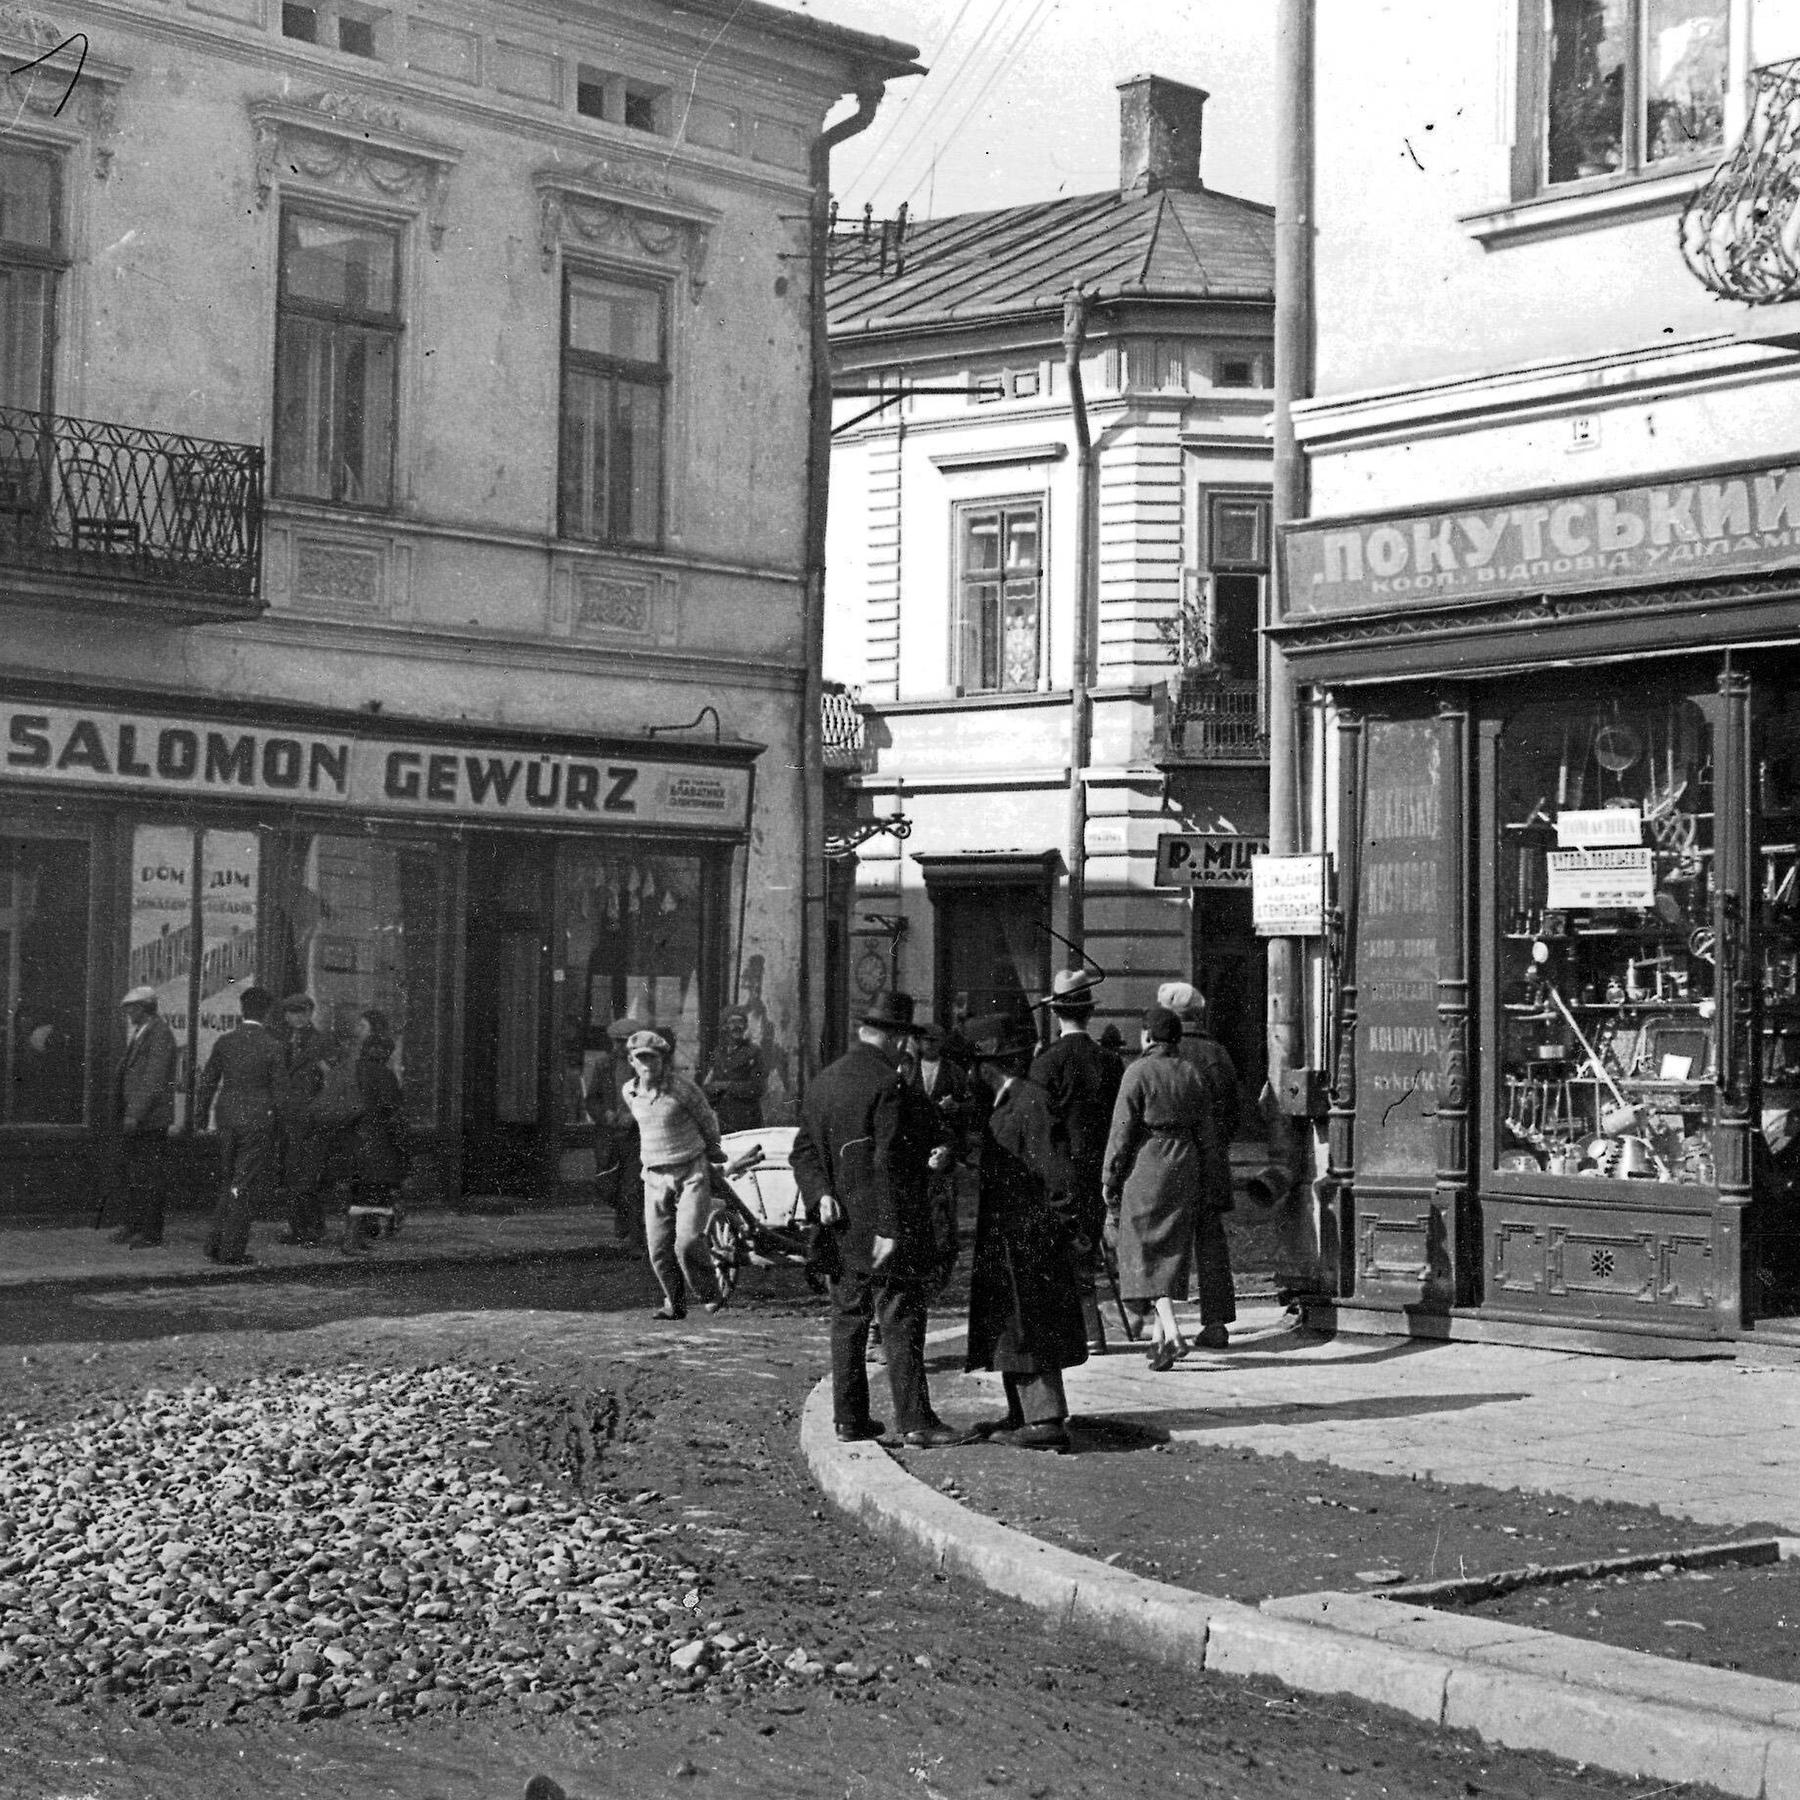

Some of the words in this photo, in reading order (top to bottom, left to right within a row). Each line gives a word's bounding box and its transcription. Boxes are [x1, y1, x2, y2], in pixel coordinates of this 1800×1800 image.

[1647, 529, 1800, 566] УДІЛАМ
[7, 713, 349, 794] SALOMON
[383, 751, 639, 814] GEWÜRZ
[142, 866, 184, 884] DOM
[211, 870, 250, 889] ДІМ
